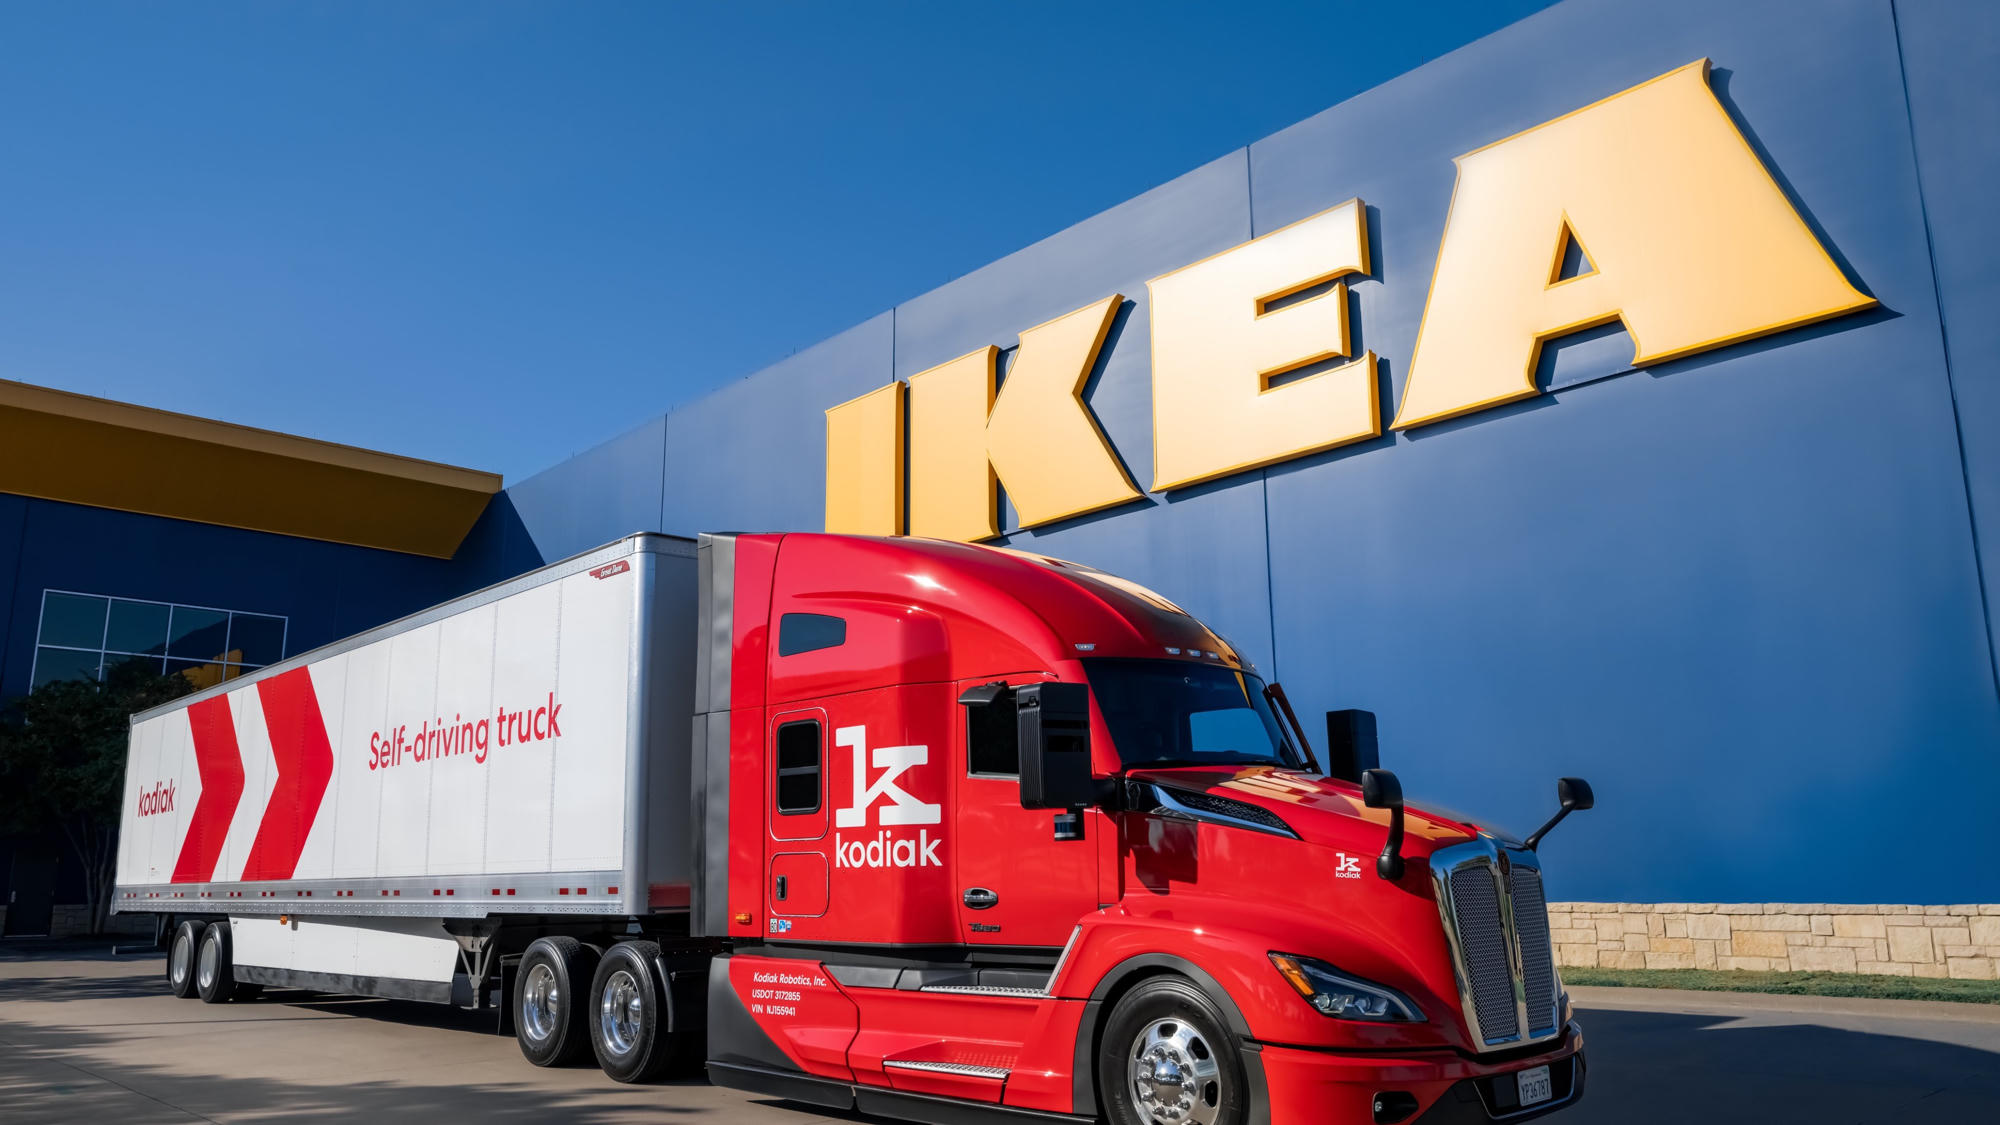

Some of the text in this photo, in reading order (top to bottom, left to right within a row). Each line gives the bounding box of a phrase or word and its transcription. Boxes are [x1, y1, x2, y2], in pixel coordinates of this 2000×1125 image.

[825, 56, 1878, 542] IKEA
[369, 692, 562, 771] Self-driving truck
[138, 778, 176, 818] kodiak
[836, 829, 943, 868] kodiak
[1335, 871, 1361, 879] kodiak
[753, 972, 827, 986] Kodiak Robotics, Inc.
[752, 989, 801, 1001] USDOT 3172855
[752, 1004, 764, 1014] VIN
